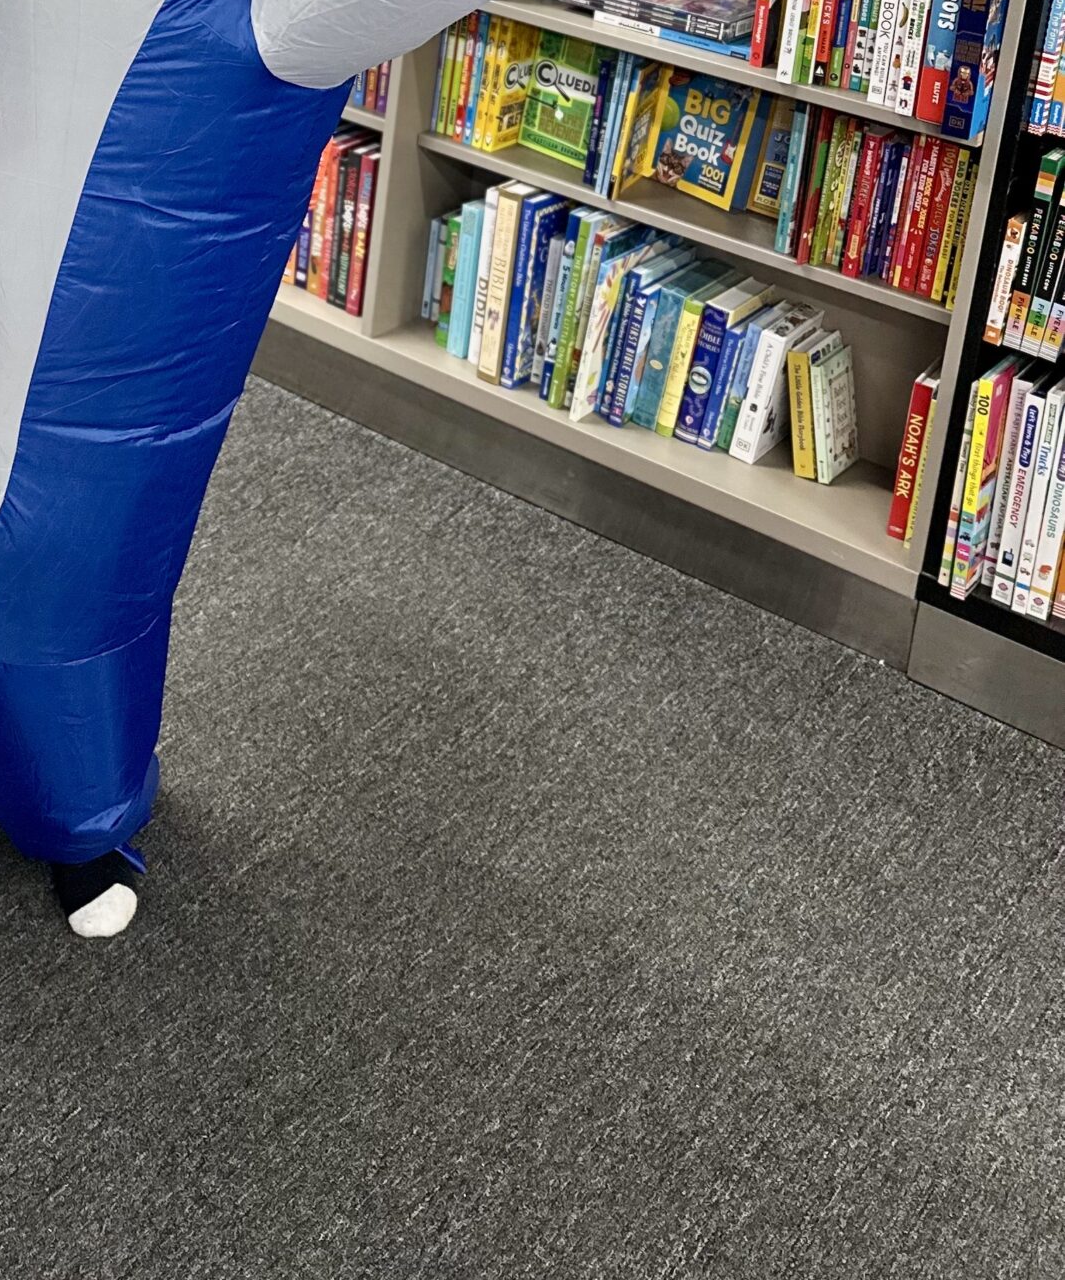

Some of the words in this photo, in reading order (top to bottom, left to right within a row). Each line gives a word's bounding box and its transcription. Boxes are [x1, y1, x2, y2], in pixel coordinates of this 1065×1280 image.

[878, 0, 895, 40] BOOK
[932, 81, 942, 105] KLUTZ
[680, 114, 726, 147] Quiz
[951, 118, 963, 127] DK
[674, 133, 721, 166] Book
[701, 163, 725, 182] 1001
[956, 160, 966, 178] DAD
[951, 179, 963, 209] JOKES
[926, 226, 941, 259] JOKES
[1026, 207, 1044, 255] PEEKABOO
[574, 254, 583, 269] THE
[487, 256, 507, 309] BIBLE
[570, 270, 581, 298] STORY
[1001, 259, 1014, 297] DINOSAUR
[566, 299, 575, 317] FOR
[636, 305, 645, 319] MY
[560, 318, 571, 345] LITTLE
[630, 320, 642, 344] FIRST
[556, 346, 565, 368] ONES
[622, 344, 636, 373] BIBLE
[794, 364, 803, 375] The
[614, 374, 630, 409] STORIES
[795, 375, 803, 391] Little
[796, 391, 804, 410] Golden
[977, 394, 990, 416] 100
[798, 425, 807, 452] Storybook
[899, 413, 925, 467] NOAH'S
[1037, 445, 1052, 476] Trucks
[895, 469, 913, 499] ARK
[1009, 468, 1026, 528] EMERGENCY
[1046, 482, 1065, 539] DINOSAURS
